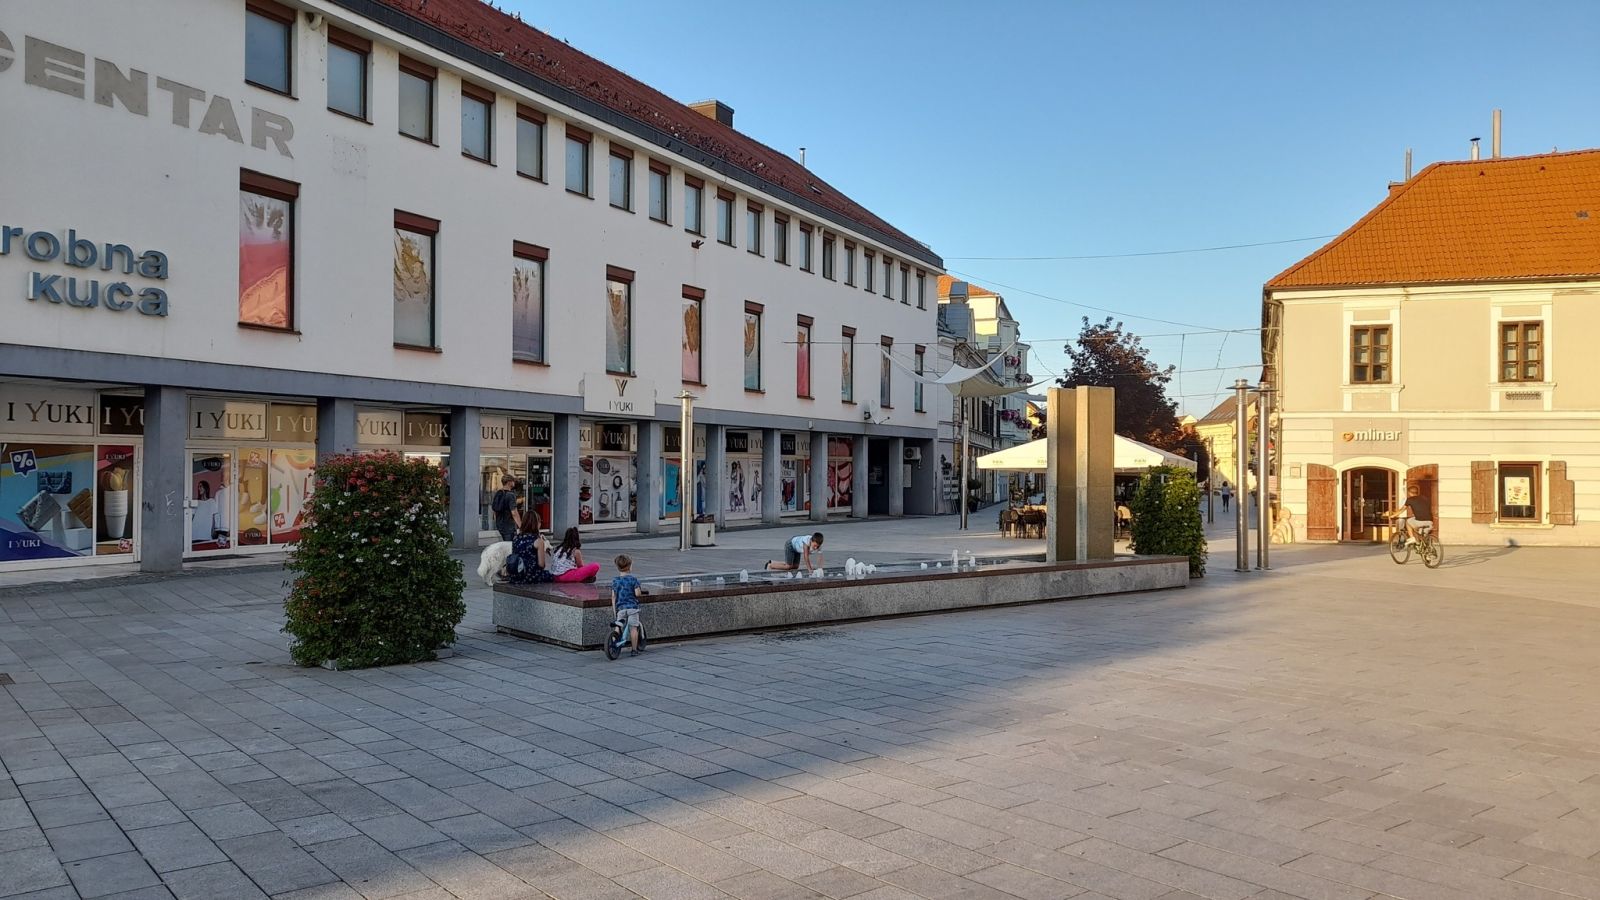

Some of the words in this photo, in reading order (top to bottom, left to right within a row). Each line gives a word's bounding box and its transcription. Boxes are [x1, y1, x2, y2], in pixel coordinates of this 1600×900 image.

[0, 30, 294, 159] ENTAR
[7, 402, 15, 421] I
[25, 399, 94, 424] YUKI
[614, 401, 633, 412] YUKI
[103, 406, 112, 425] I
[195, 411, 202, 429] I
[209, 409, 263, 431] YUKI
[275, 415, 282, 432] I
[356, 417, 398, 436] YUKI
[408, 422, 413, 437] I
[418, 420, 448, 438] YUK
[511, 425, 515, 439] I
[519, 425, 549, 441] YUKI
[1355, 428, 1402, 442] mlinar
[596, 431, 600, 444] I
[603, 430, 628, 444] YUKI
[9, 541, 12, 549] I
[16, 539, 41, 548] YUKI
